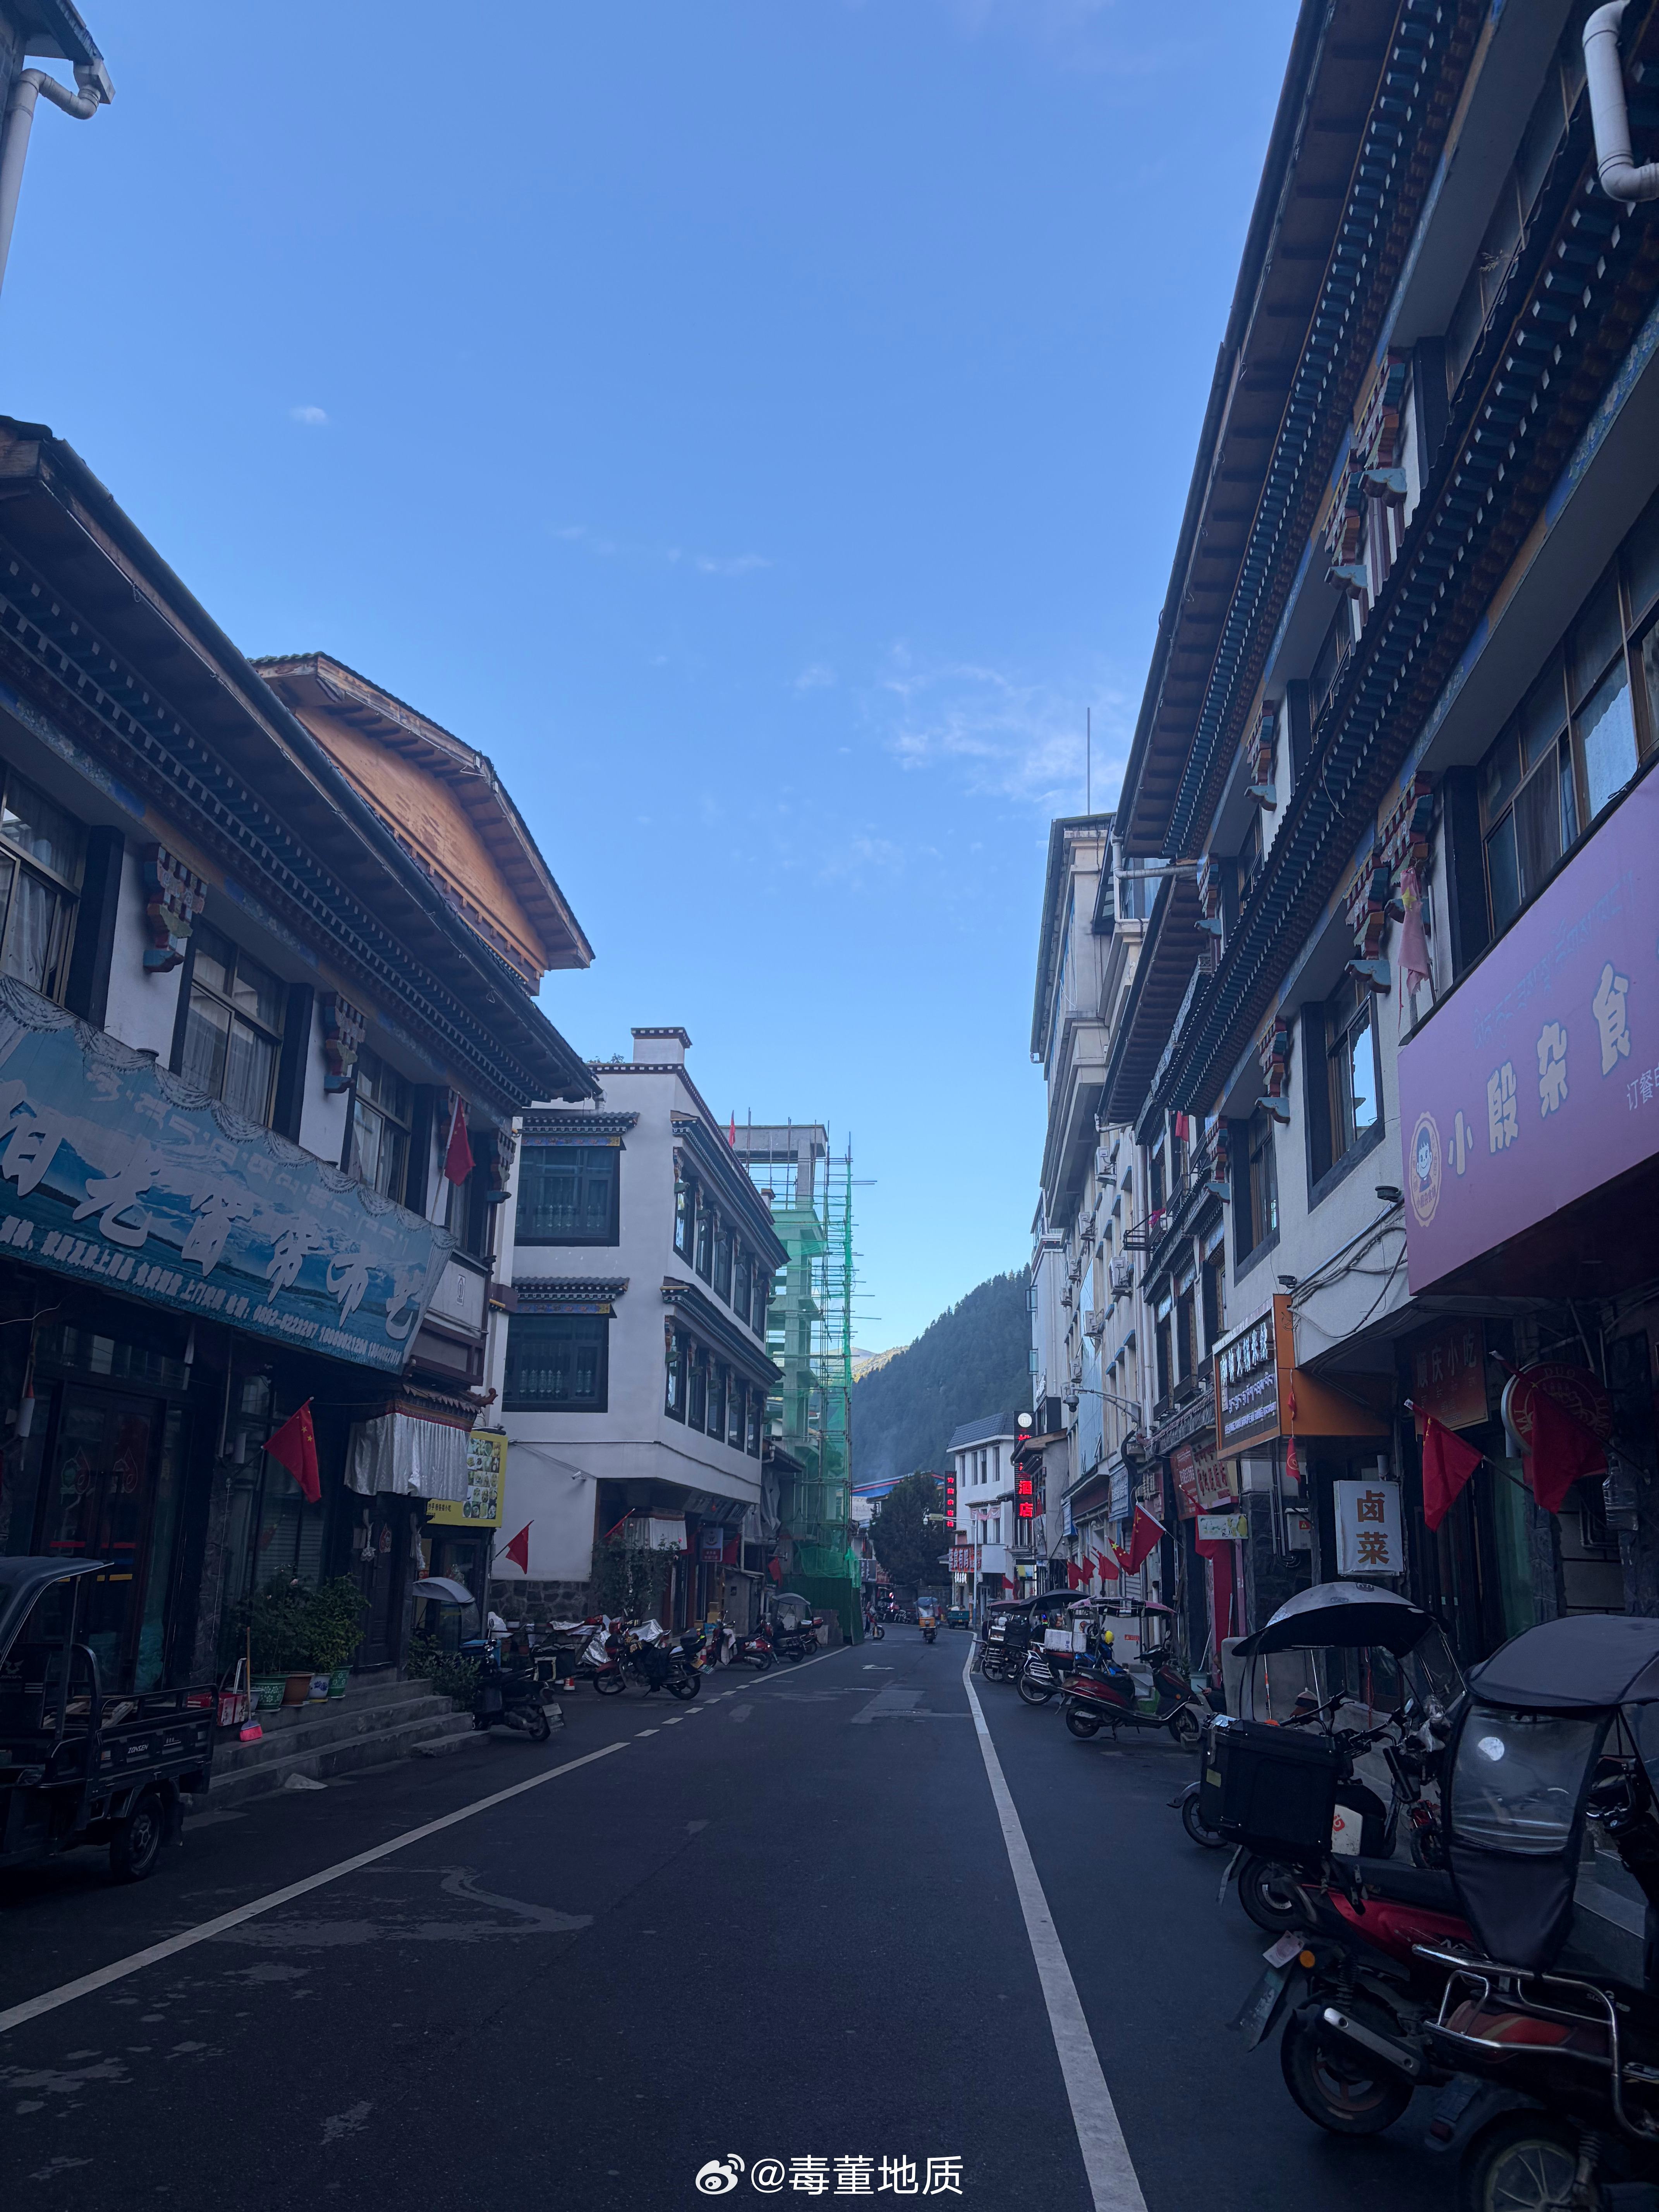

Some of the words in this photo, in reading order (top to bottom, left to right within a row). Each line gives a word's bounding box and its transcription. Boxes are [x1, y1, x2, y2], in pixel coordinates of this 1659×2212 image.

[1417, 1328, 1477, 1389] 顺庆小吃
[1543, 1367, 1576, 1378] DUO
[1357, 1490, 1390, 1565] 卤菜
[127, 1743, 149, 1754] ZONSEN
